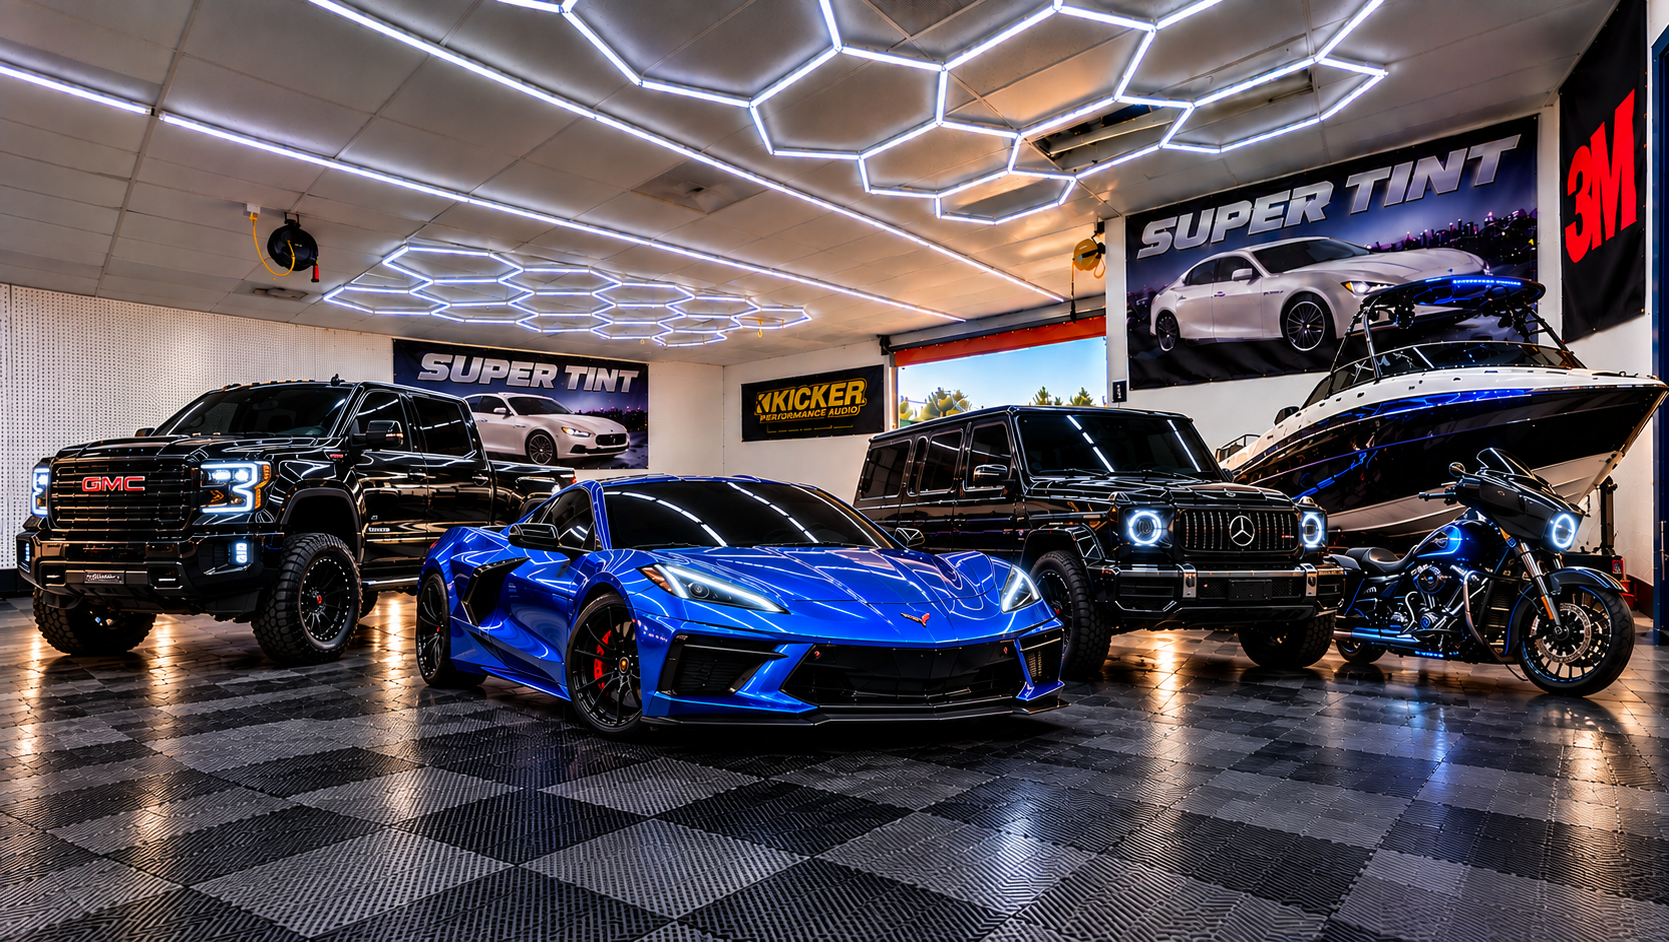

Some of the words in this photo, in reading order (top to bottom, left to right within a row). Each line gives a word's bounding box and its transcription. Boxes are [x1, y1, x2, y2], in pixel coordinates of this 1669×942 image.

[1565, 88, 1637, 263] 3M
[1136, 180, 1335, 260] SUPER
[1345, 133, 1522, 215] TINT
[417, 352, 558, 389] SUPER
[564, 364, 640, 393] TINT
[756, 380, 866, 413] KICKER
[760, 408, 827, 423] PERFORMANCE
[827, 405, 858, 417] AUDIO
[82, 476, 145, 492] GMC
